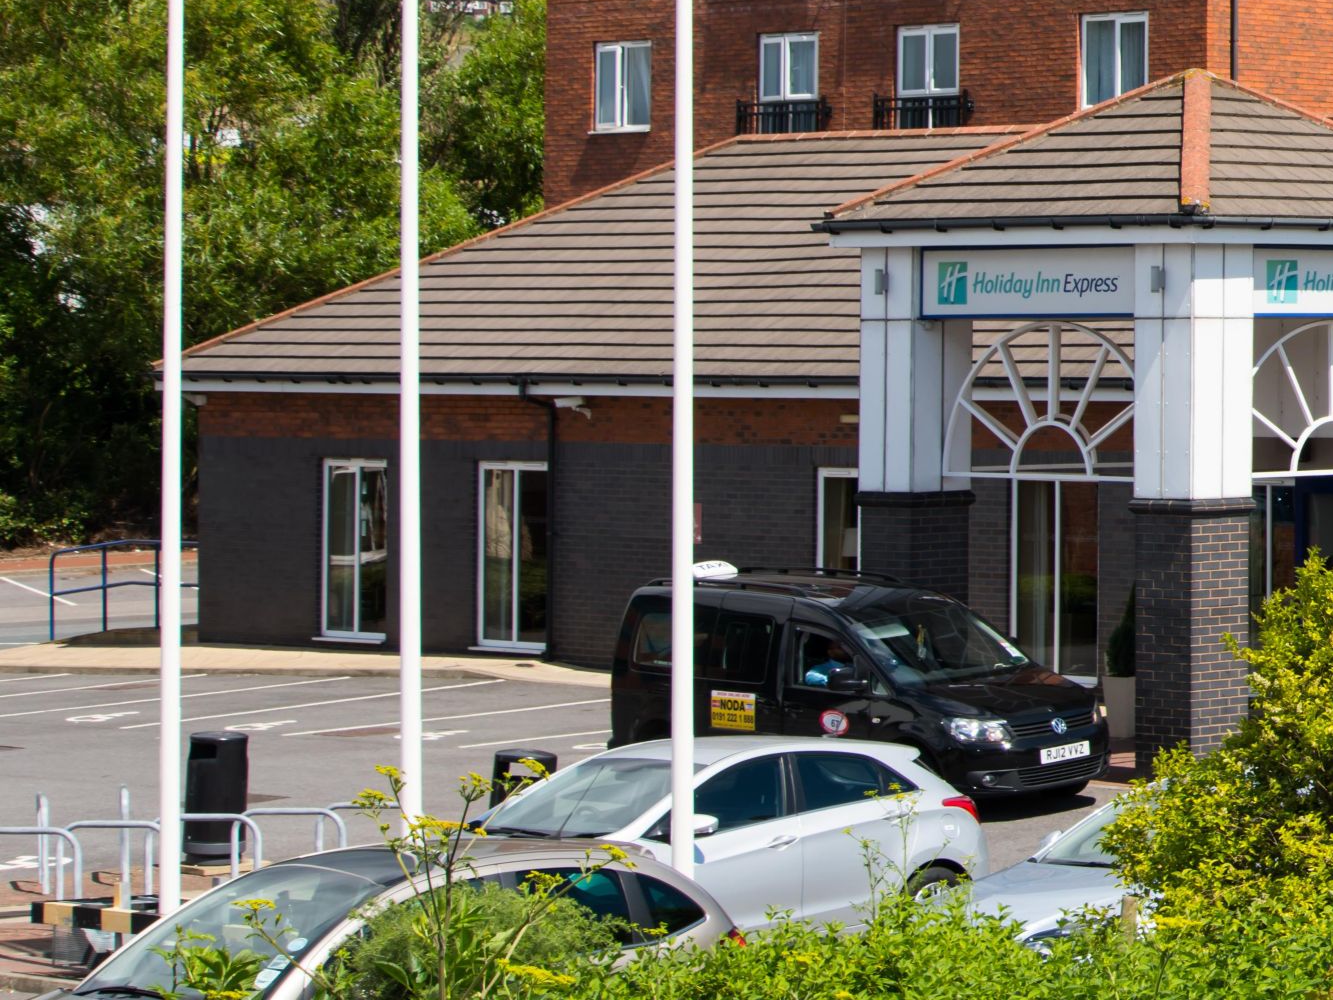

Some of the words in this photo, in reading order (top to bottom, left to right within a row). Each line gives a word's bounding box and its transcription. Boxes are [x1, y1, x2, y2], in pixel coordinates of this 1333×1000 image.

[973, 271, 1032, 298] Holiday
[1036, 271, 1060, 293] Inn
[1063, 274, 1118, 297] Express
[720, 699, 745, 711] NODA
